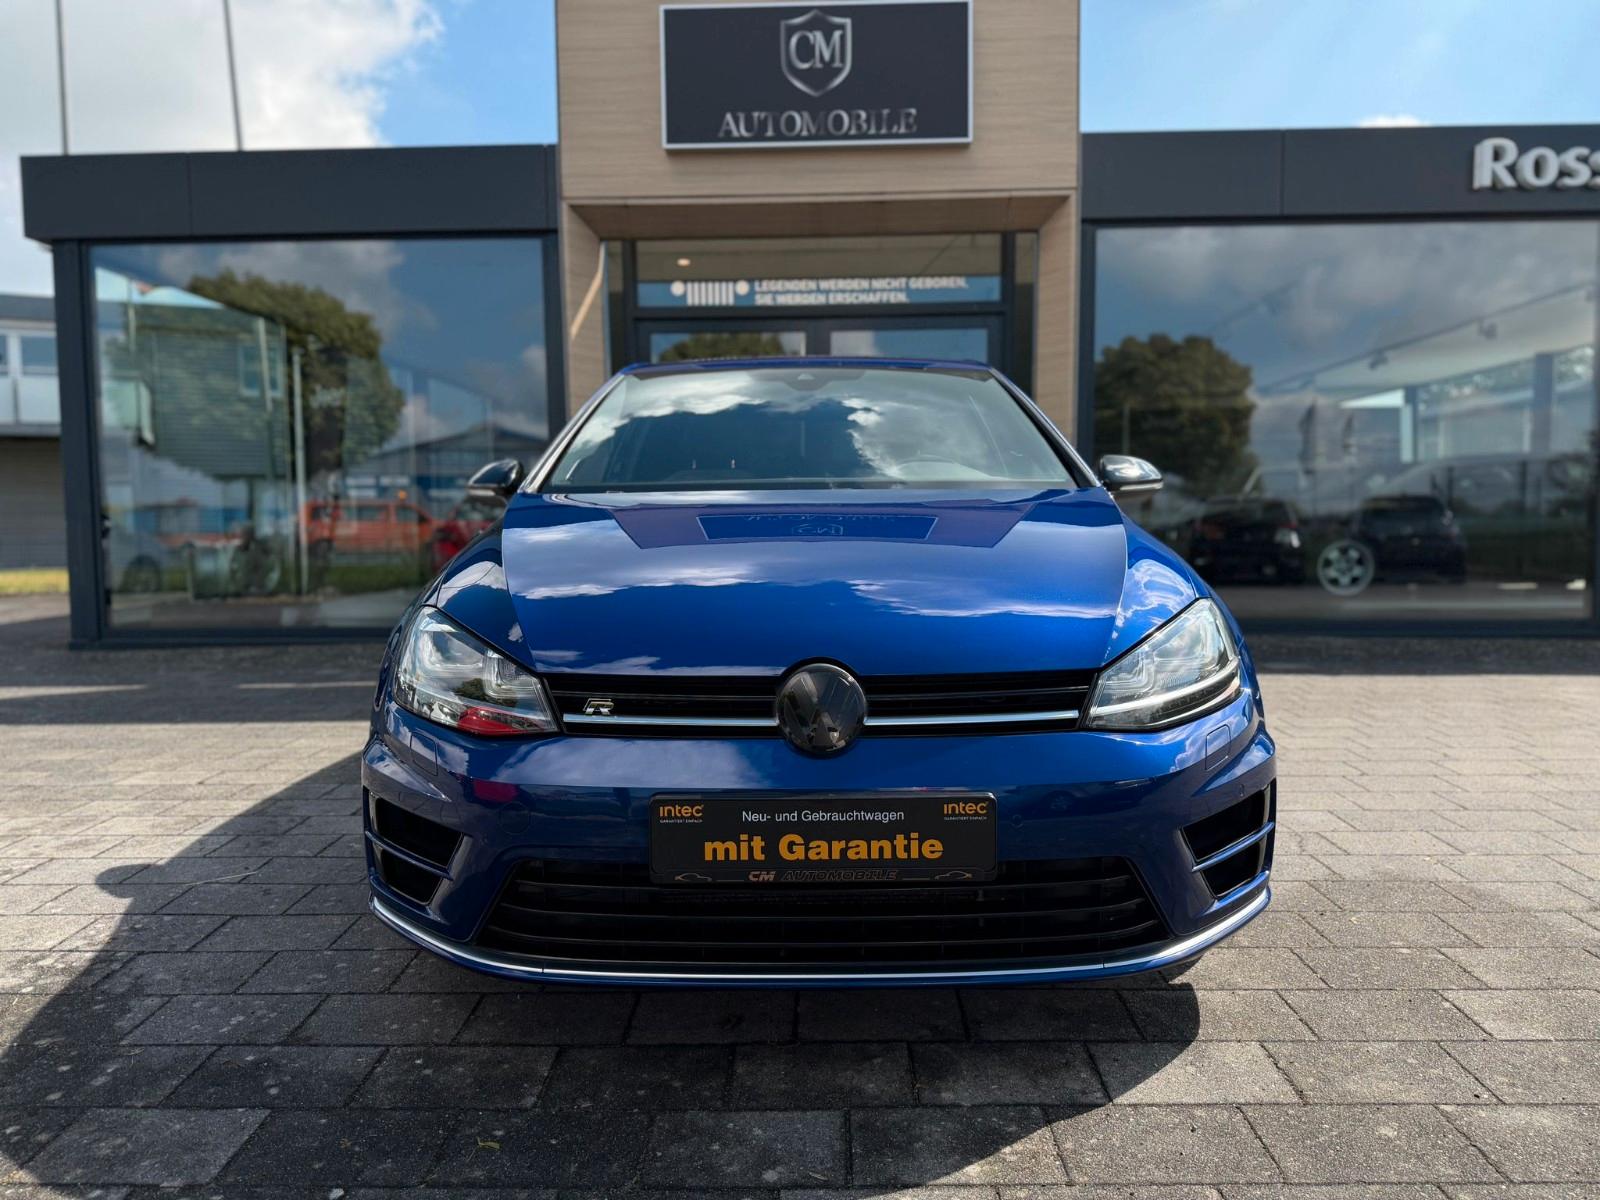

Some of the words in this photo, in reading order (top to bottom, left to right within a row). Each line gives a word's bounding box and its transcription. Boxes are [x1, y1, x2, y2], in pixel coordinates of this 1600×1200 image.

[789, 30, 843, 69] CM
[718, 108, 918, 138] AUTOMOBILE
[754, 279, 817, 292] LEGENDEN
[819, 278, 870, 291] WERDEN
[872, 277, 908, 289] NICHT
[755, 292, 774, 305] SIE
[776, 292, 827, 305] WERDEN
[742, 811, 771, 822] Neu-
[775, 811, 798, 822] und
[801, 810, 904, 823] Gebrauchtwagen
[704, 834, 765, 861] mit
[778, 832, 944, 861] Garantie
[748, 871, 776, 881] CM
[783, 869, 897, 881] AUTOMOBILE
